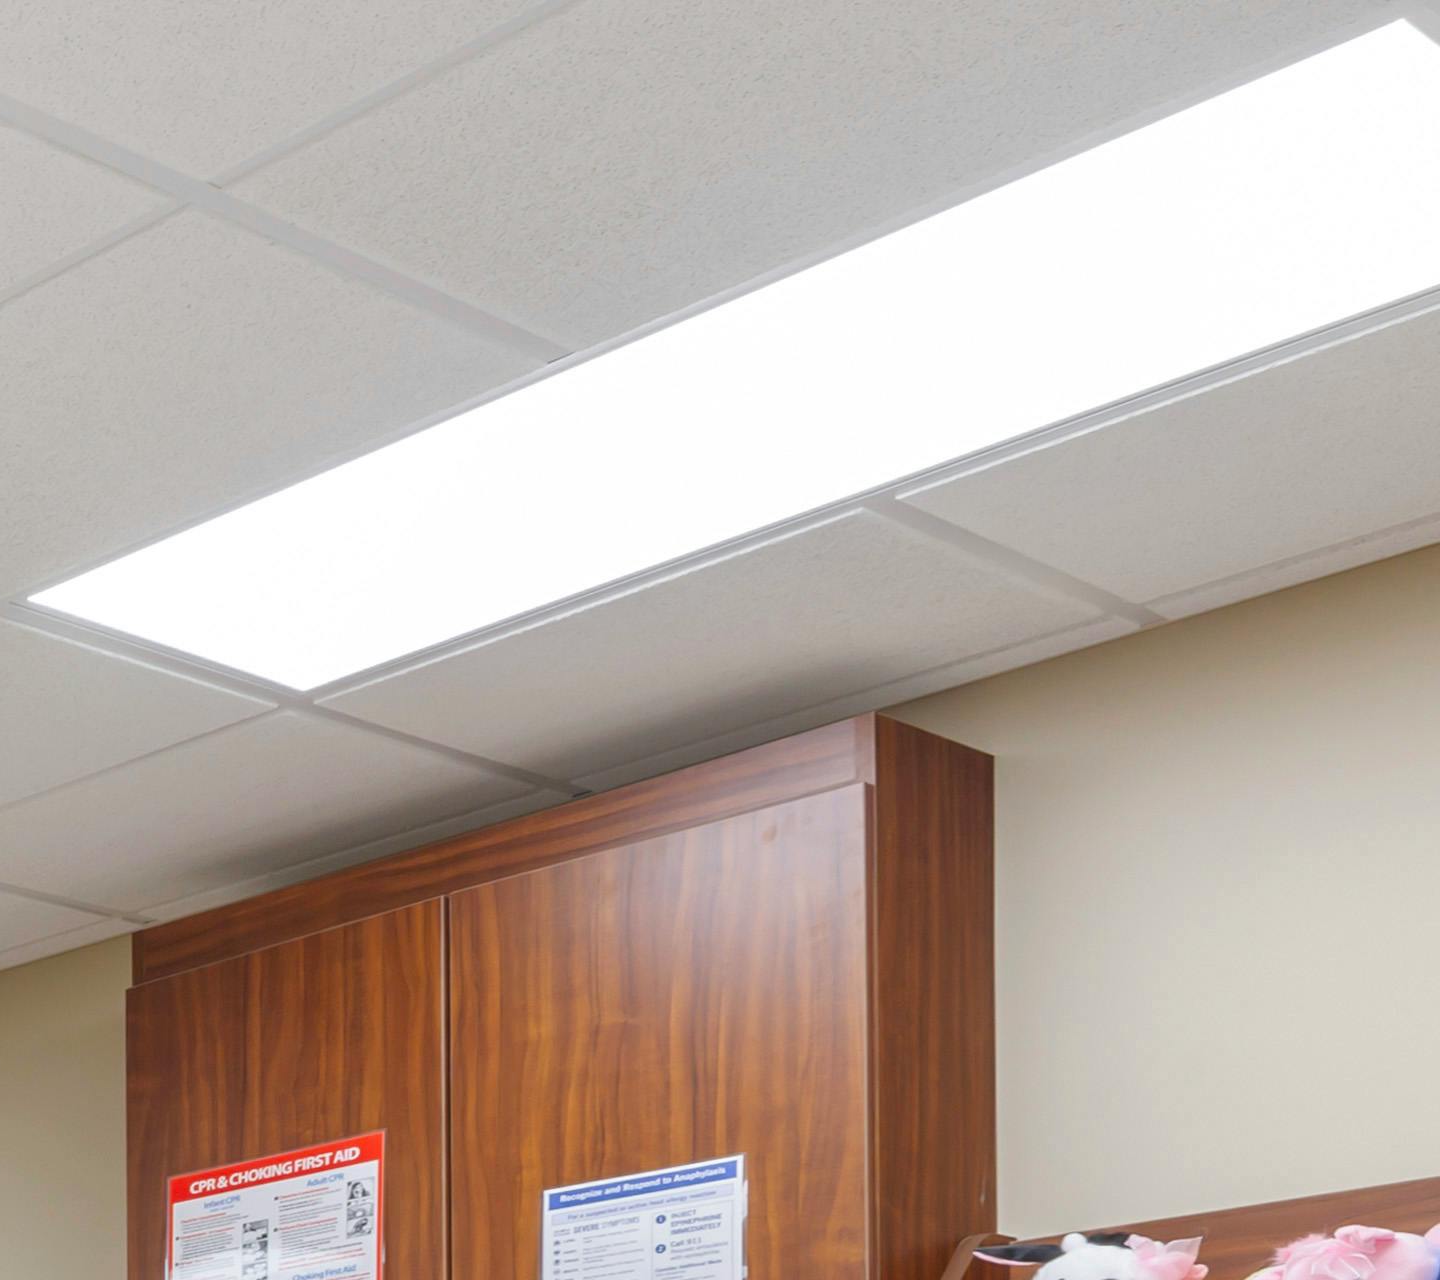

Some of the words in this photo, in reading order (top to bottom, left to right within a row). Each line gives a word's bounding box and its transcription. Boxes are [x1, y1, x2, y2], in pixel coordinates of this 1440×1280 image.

[189, 1179, 215, 1195] CPR
[217, 1176, 228, 1188] &
[229, 1164, 293, 1186] CHOKING
[294, 1153, 332, 1172] FIRST
[333, 1146, 361, 1164] AID
[559, 1188, 603, 1203] Recognize
[604, 1185, 621, 1195] and
[622, 1177, 661, 1192] Respond
[662, 1176, 672, 1185] to
[325, 1267, 345, 1277] First
[345, 1265, 357, 1273] Aid
